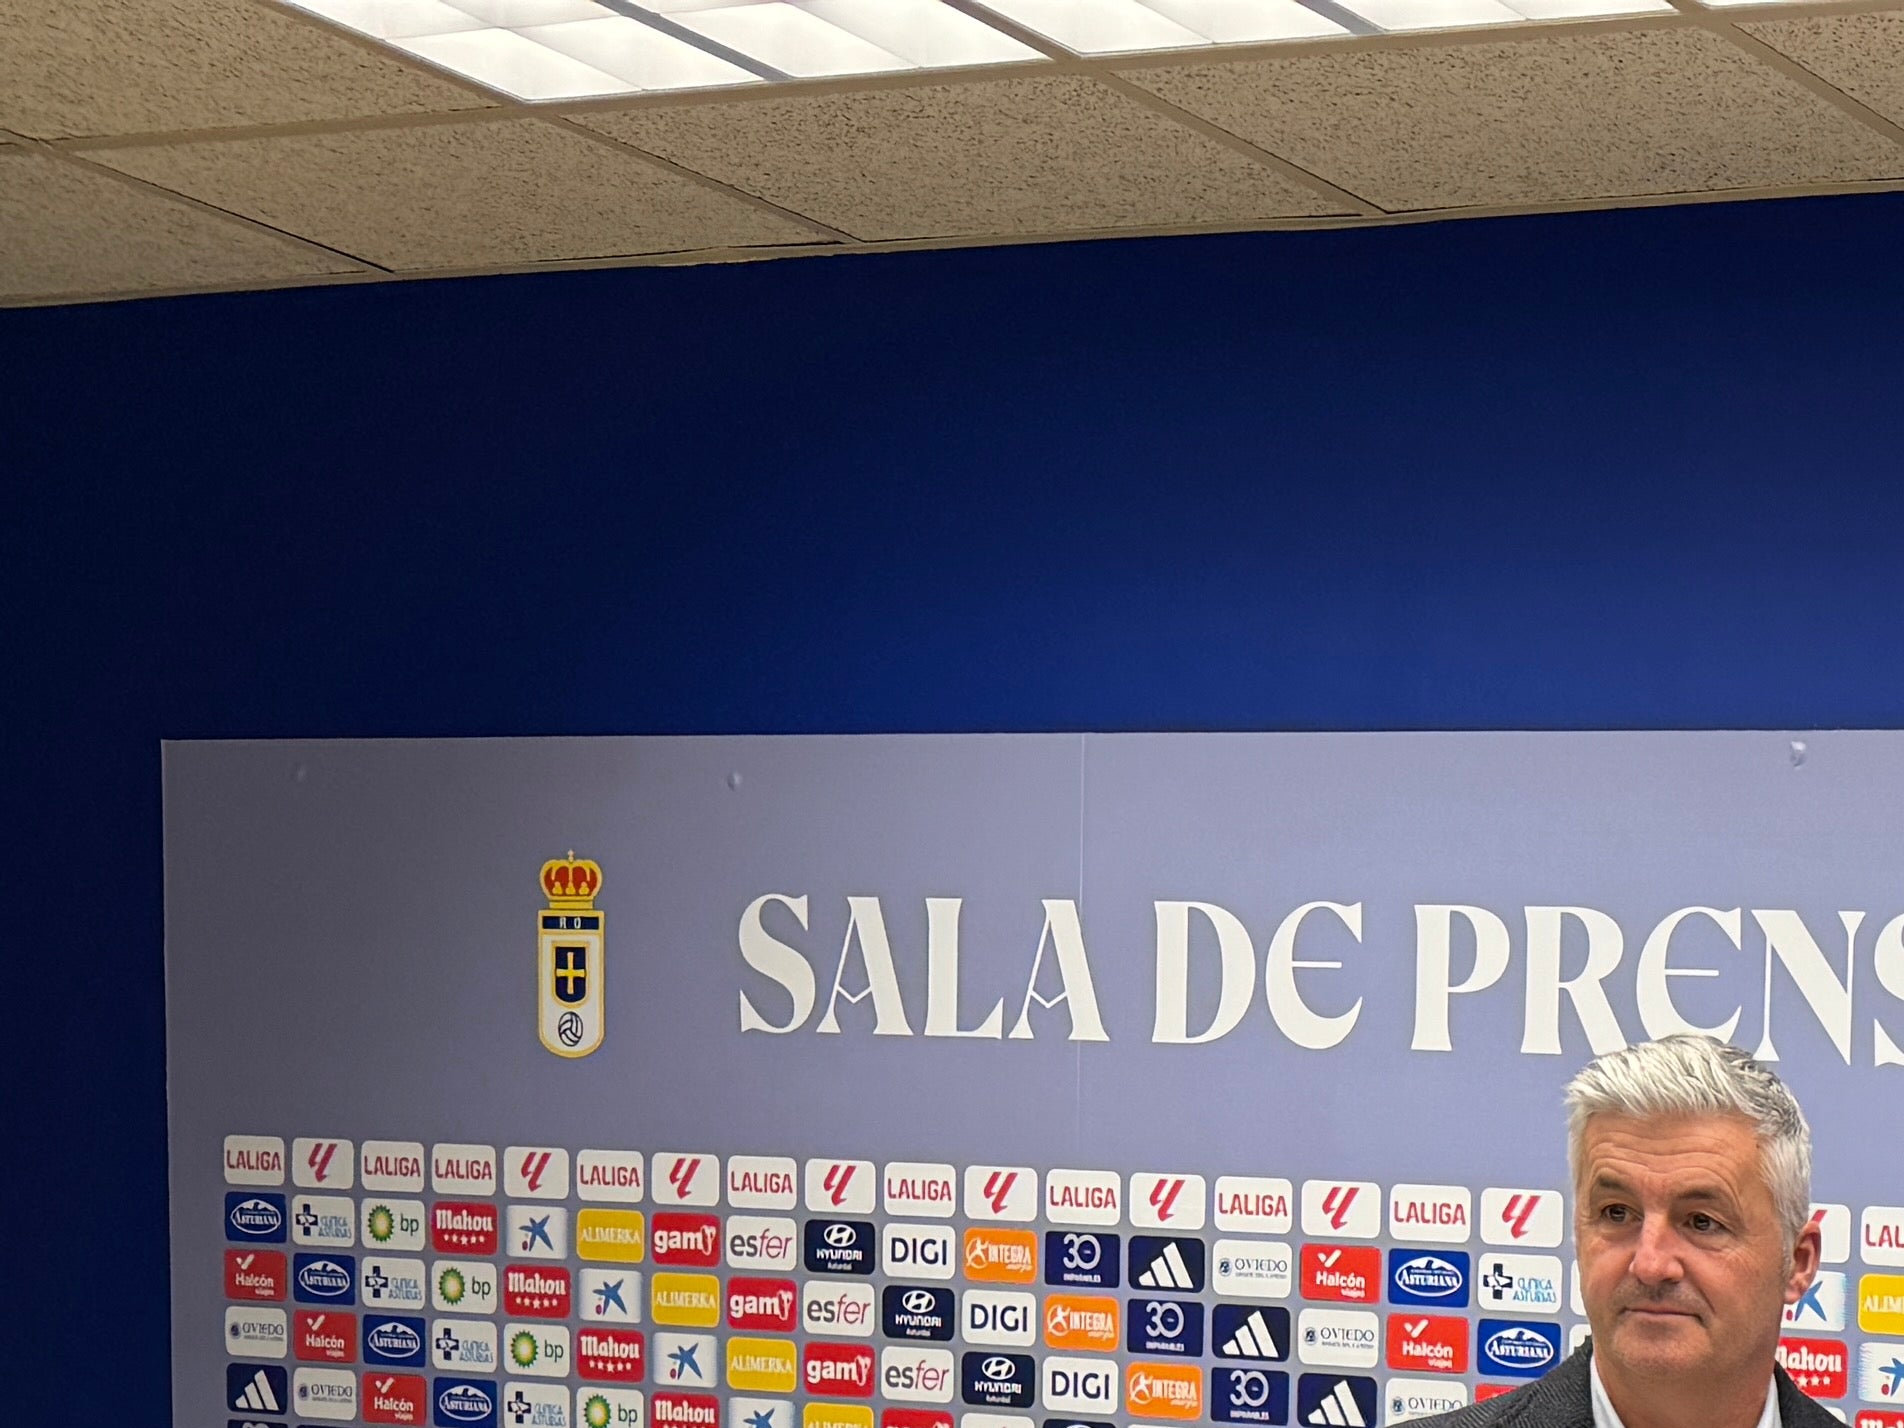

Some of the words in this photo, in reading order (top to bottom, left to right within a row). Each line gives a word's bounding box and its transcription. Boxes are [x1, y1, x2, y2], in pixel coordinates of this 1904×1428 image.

[738, 892, 1110, 1042] SALA
[1152, 900, 1363, 1052] DE
[227, 1150, 281, 1171] LALIGA
[580, 1165, 640, 1187] LALIGA
[731, 1171, 793, 1193] LALIGA
[888, 1178, 951, 1201] LALIGA
[1219, 1193, 1287, 1217] LALIGA
[400, 1215, 419, 1234] bp
[436, 1209, 493, 1231] Mahou
[730, 1231, 792, 1259] esfer
[891, 1238, 946, 1265] DIGI
[1235, 1258, 1287, 1273] OVIEDO
[508, 1272, 565, 1294] Mahou
[1316, 1271, 1365, 1290] Halcón
[807, 1295, 870, 1324] esfer
[971, 1304, 1027, 1332] DIGI
[242, 1323, 285, 1336] OVIEDO
[1052, 1371, 1109, 1400] DIGI
